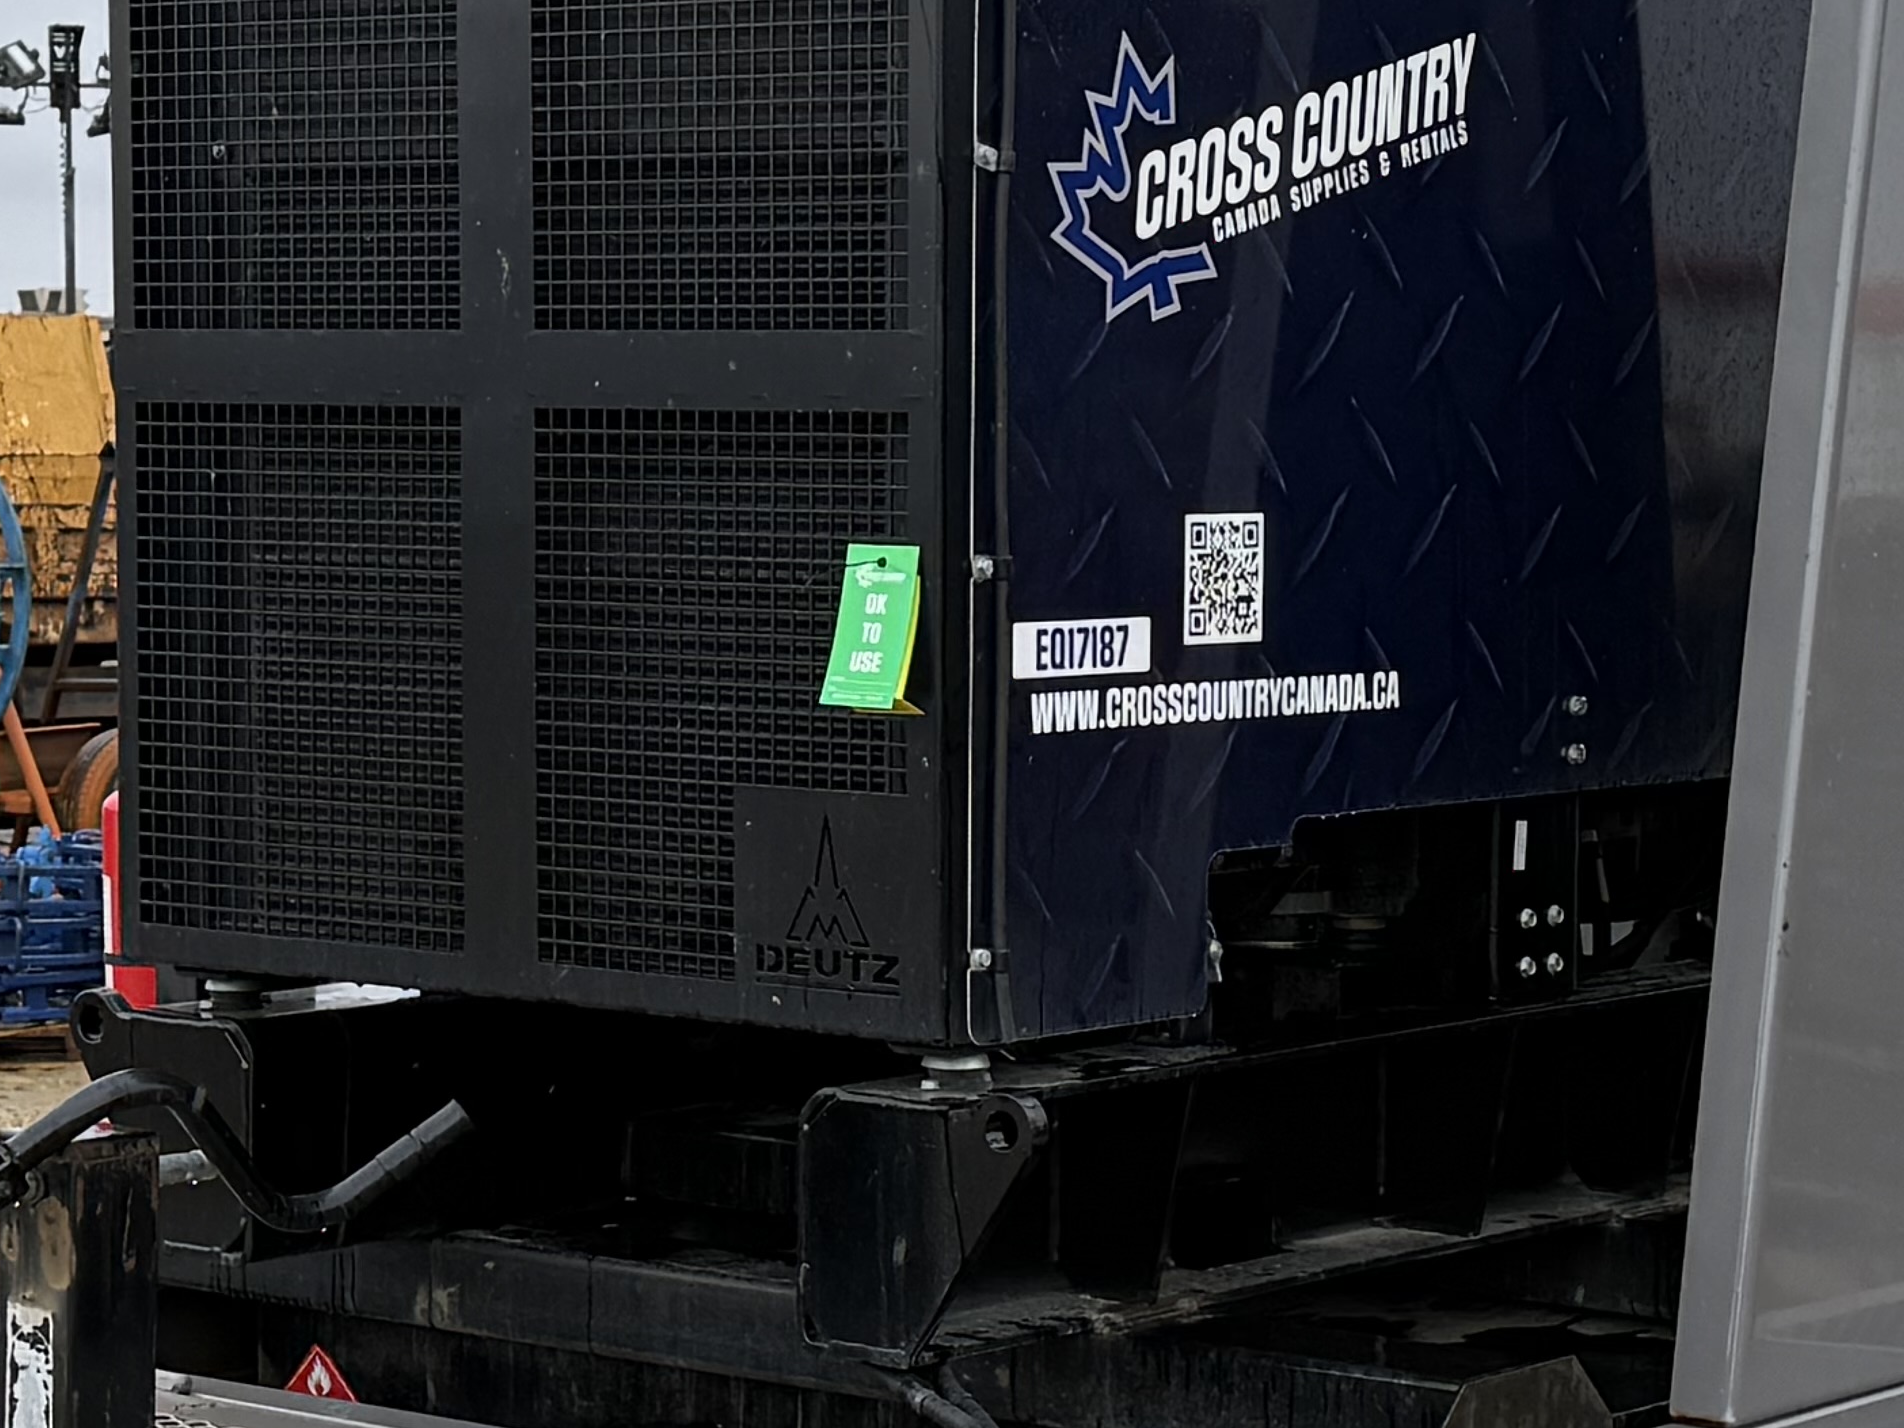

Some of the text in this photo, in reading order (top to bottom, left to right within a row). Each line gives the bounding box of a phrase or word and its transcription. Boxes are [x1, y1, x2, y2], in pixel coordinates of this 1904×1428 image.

[1135, 32, 1477, 240] CROSS COUNTRY
[1212, 120, 1469, 243] CANADA SUPPLIES & RENTALS
[864, 592, 889, 616] OK
[861, 622, 882, 645] TO
[1035, 625, 1130, 671] EQ17187
[849, 651, 884, 673] USE
[1030, 670, 1400, 735] WWW.CROSSCOUNTRYCANADA.CA
[756, 943, 900, 986] DEUTZ
